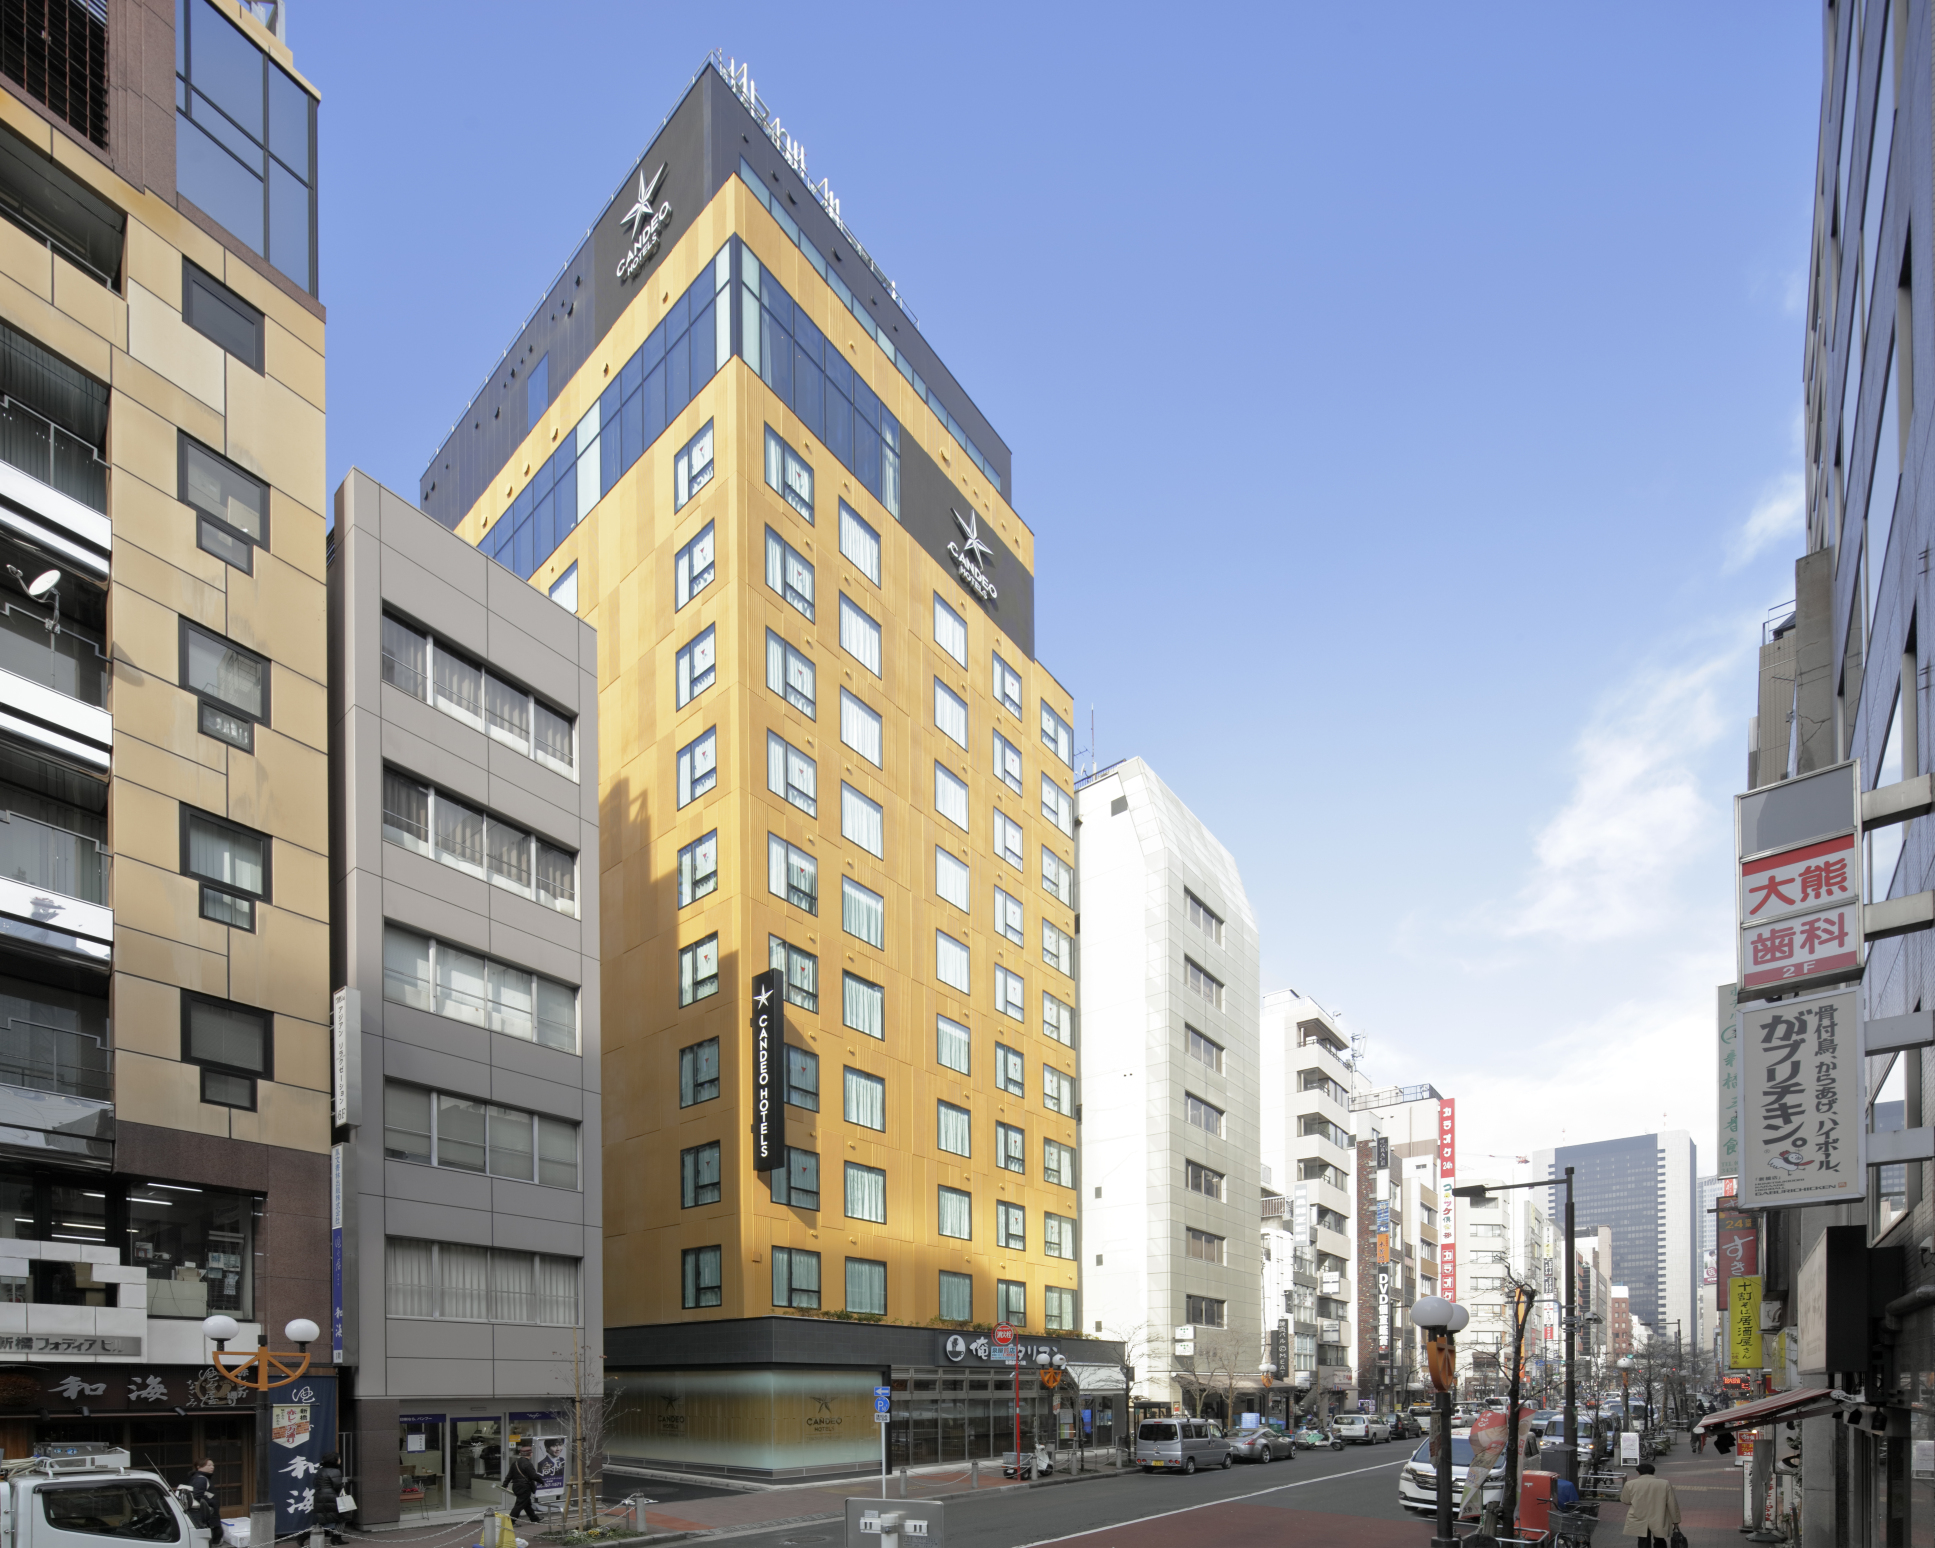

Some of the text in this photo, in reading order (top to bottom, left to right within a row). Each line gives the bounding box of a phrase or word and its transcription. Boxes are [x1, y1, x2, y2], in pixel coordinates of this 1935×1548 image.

[616, 201, 670, 277] CANDEO
[627, 232, 659, 276] HOTELS
[947, 541, 998, 599] CANDEO
[958, 565, 988, 600] HOTELS
[1748, 857, 1849, 916] 大熊
[1749, 911, 1849, 966] 歯科
[758, 1014, 769, 1157] CANDEO HOTELS
[1442, 1106, 1452, 1158] カラオケ
[1754, 1184, 1837, 1197] GABURICHICKEN
[1725, 1218, 1744, 1230] 24
[1443, 1251, 1453, 1301] カラオケ
[1736, 1281, 1754, 1360] 十割そば居酒屋さん
[47, 1374, 169, 1402] 和海
[877, 1400, 884, 1411] P
[286, 1408, 297, 1445] 赤レンガ通り
[300, 1407, 308, 1421] 新橋
[806, 1417, 843, 1426] CANDEO
